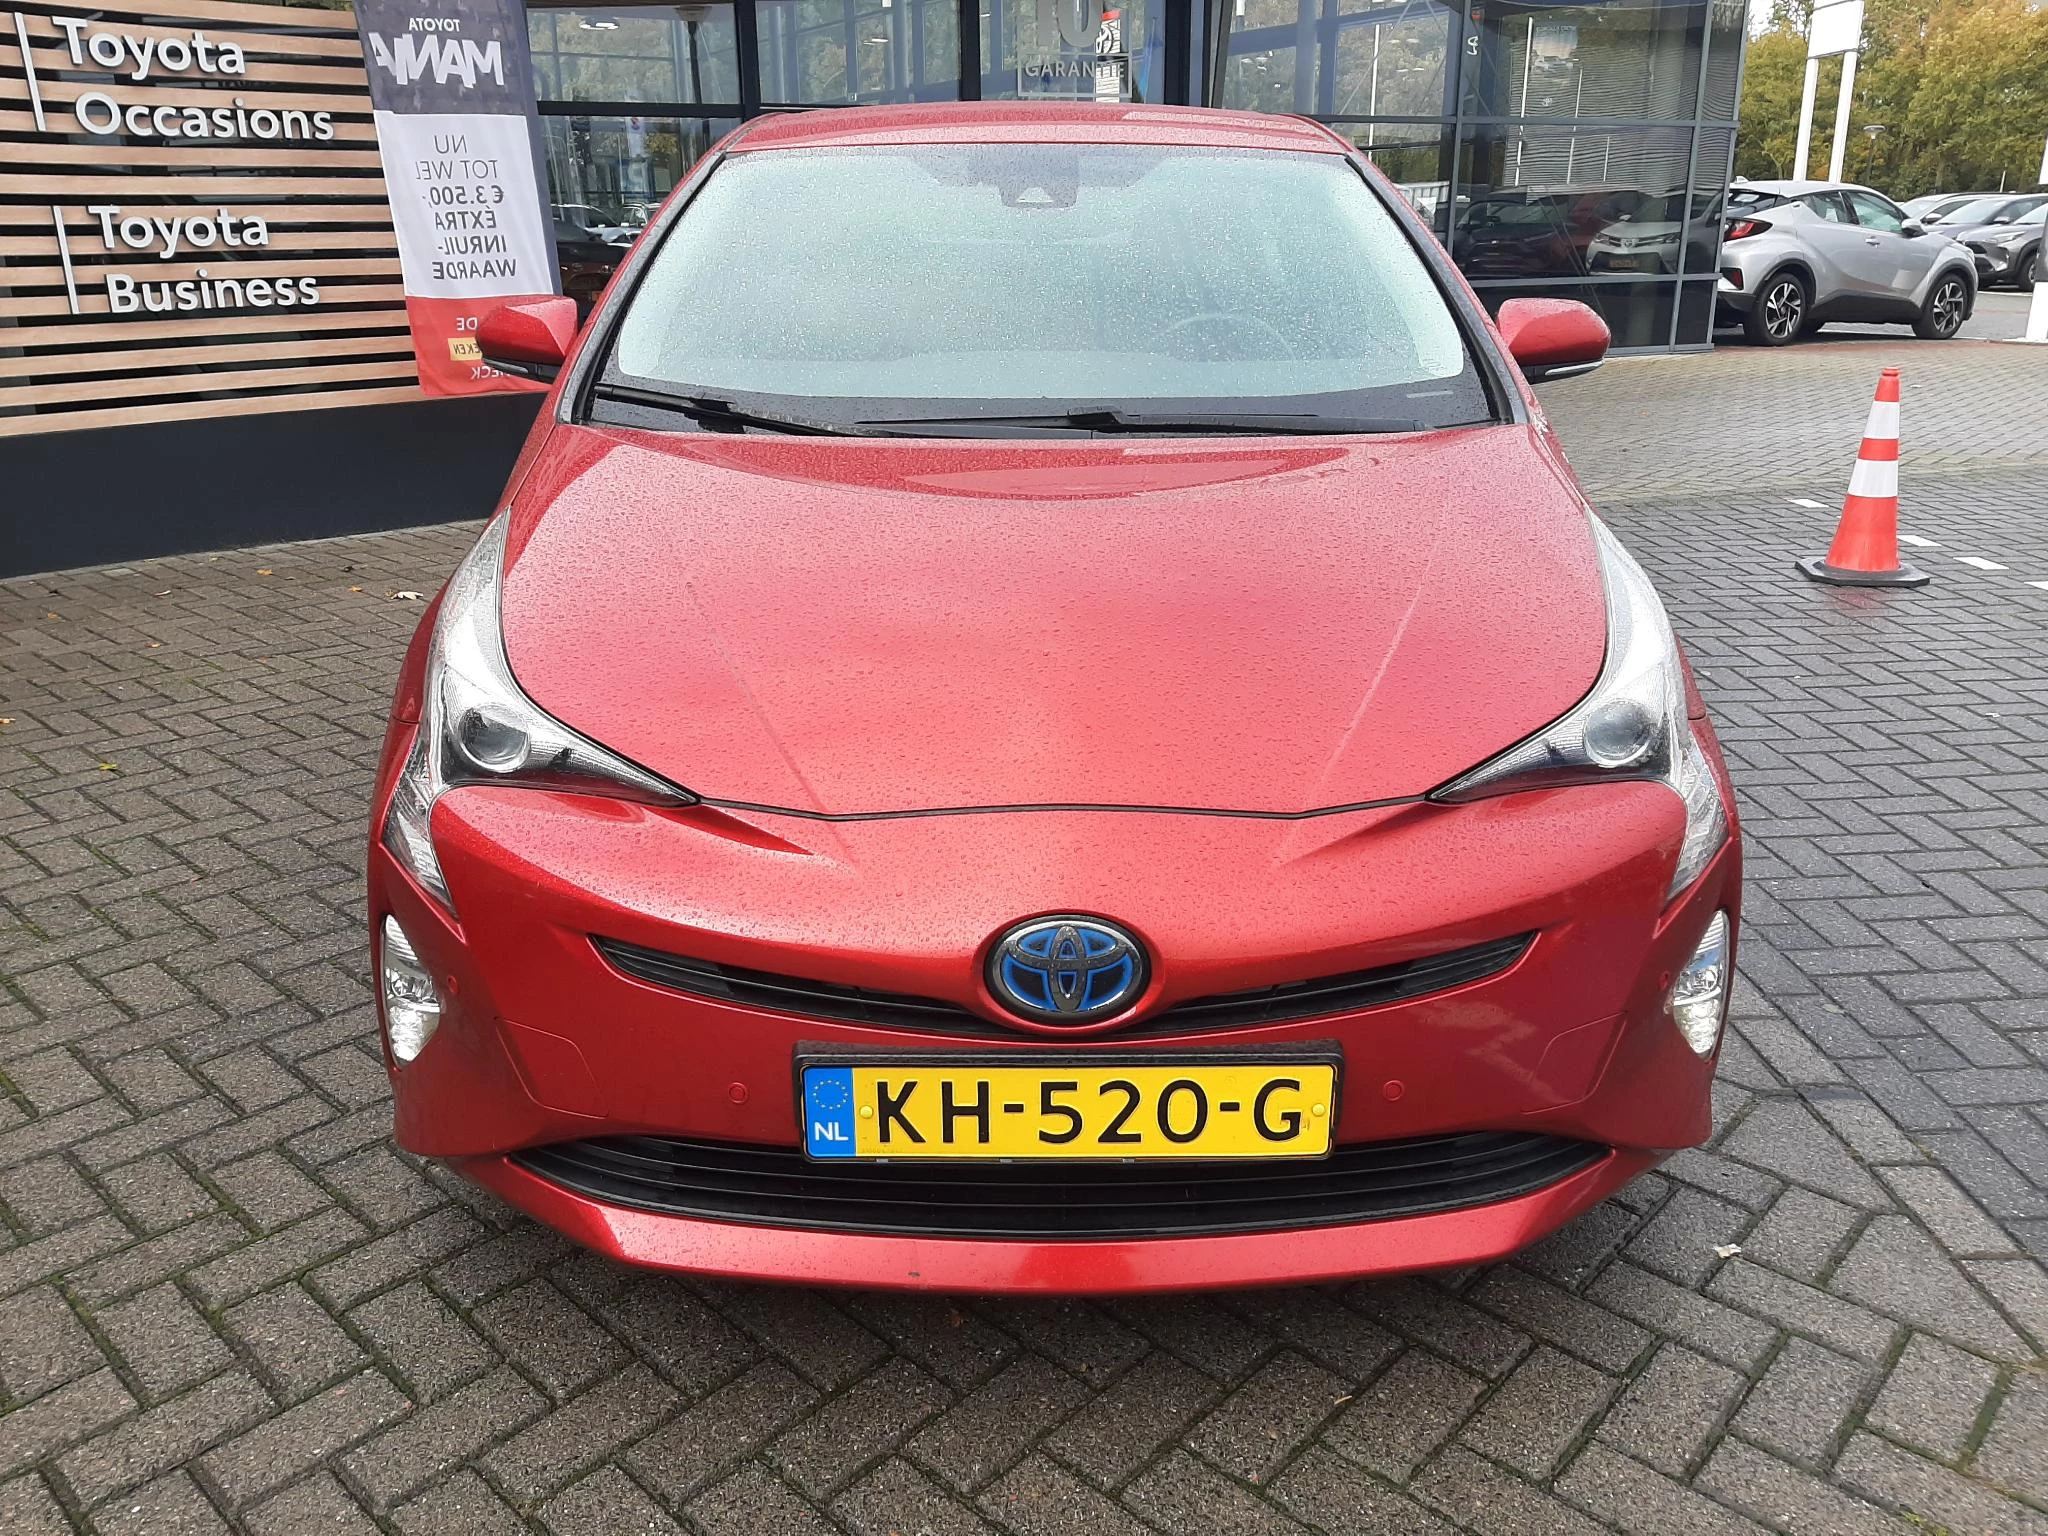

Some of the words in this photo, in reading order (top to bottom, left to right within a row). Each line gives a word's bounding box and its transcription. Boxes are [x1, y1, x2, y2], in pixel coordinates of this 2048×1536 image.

[52, 15, 246, 81] Toyota
[1025, 60, 1125, 78] GARANTIE
[75, 91, 335, 141] Occasions
[87, 204, 270, 259] Toyota
[105, 268, 321, 314] Business
[814, 1121, 849, 1141] NL
[876, 1079, 1302, 1144] KH-520-G
